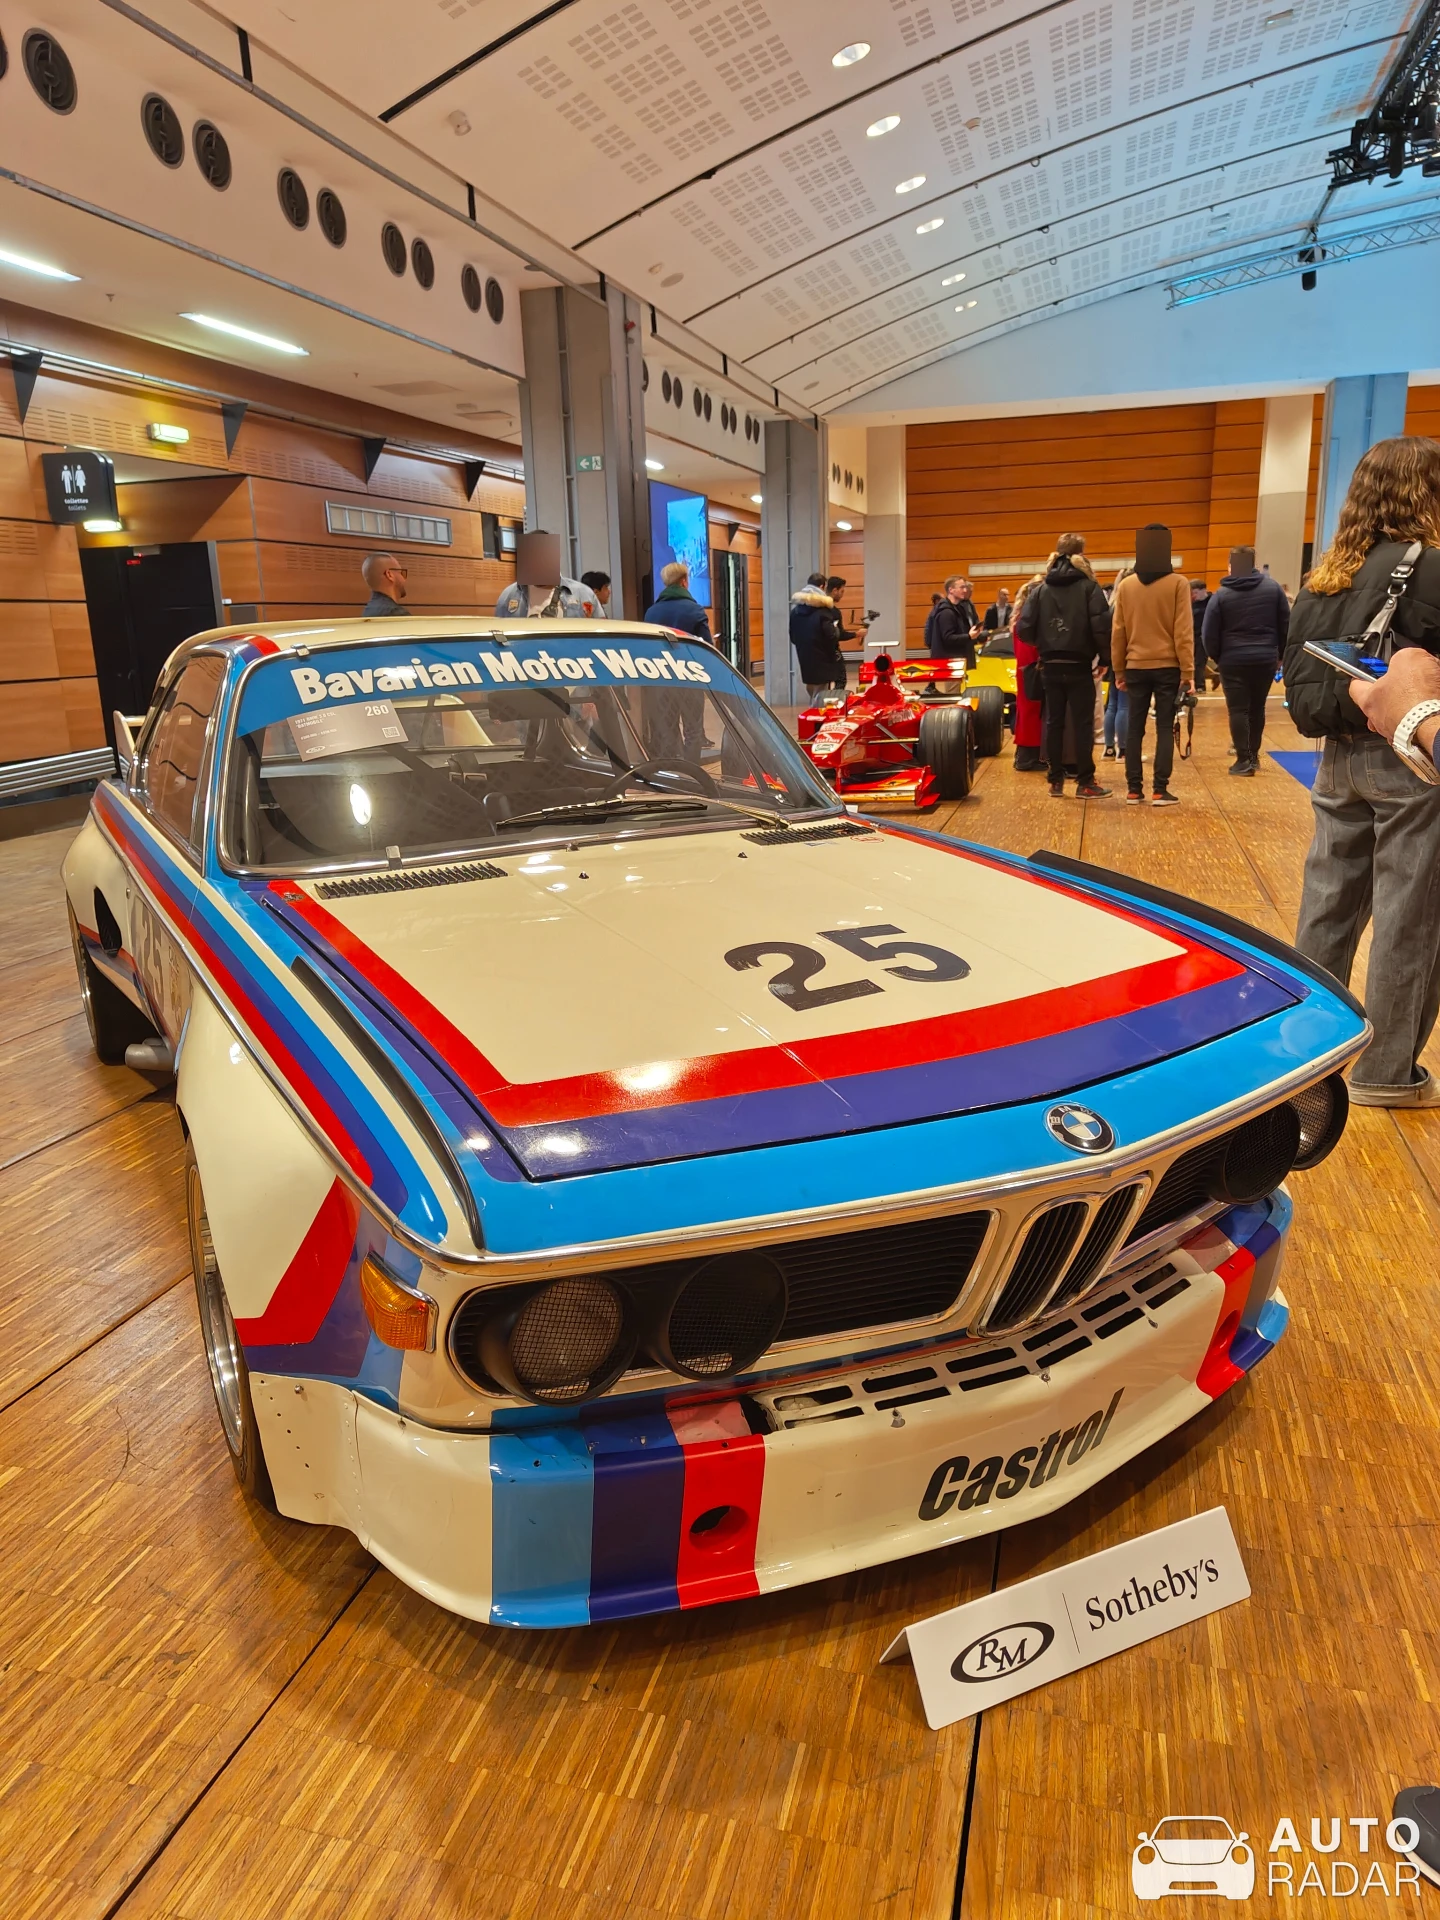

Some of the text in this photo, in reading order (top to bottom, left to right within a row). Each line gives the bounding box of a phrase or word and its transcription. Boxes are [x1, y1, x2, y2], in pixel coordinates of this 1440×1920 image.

[291, 648, 711, 704] Bavarian Motor Works
[364, 705, 389, 717] 260
[724, 924, 972, 1012] 25
[1049, 1105, 1094, 1125] BMW
[918, 1386, 1125, 1521] Castrol
[976, 1558, 1219, 1673] RM Sotheby's
